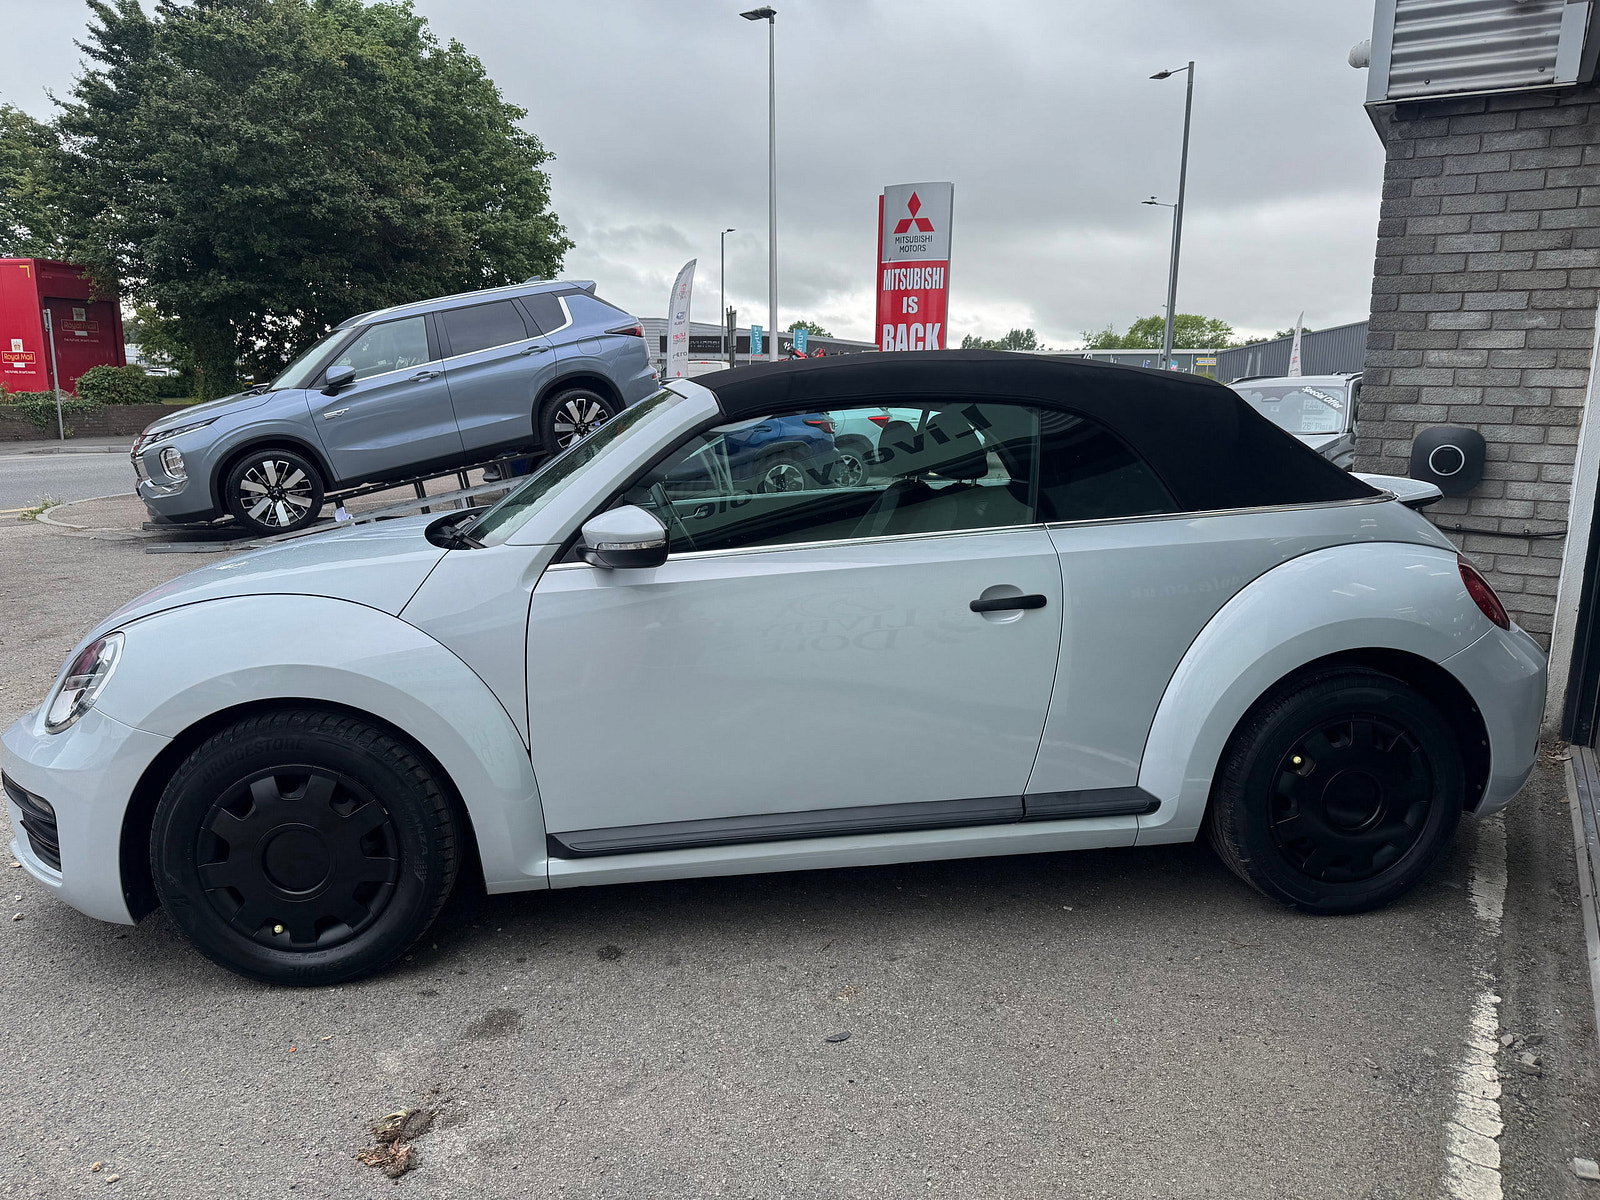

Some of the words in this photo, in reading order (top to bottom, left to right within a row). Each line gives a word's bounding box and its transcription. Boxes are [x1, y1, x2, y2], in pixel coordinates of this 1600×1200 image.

[894, 235, 933, 245] MITSUBISHI
[899, 244, 927, 253] MOTORS
[883, 267, 944, 291] MITSUBISHI
[902, 296, 919, 314] IS
[882, 322, 942, 352] BACK
[3, 352, 20, 362] Royal
[20, 353, 34, 361] Mail
[1302, 386, 1328, 400] Special
[1323, 396, 1344, 409] Offer
